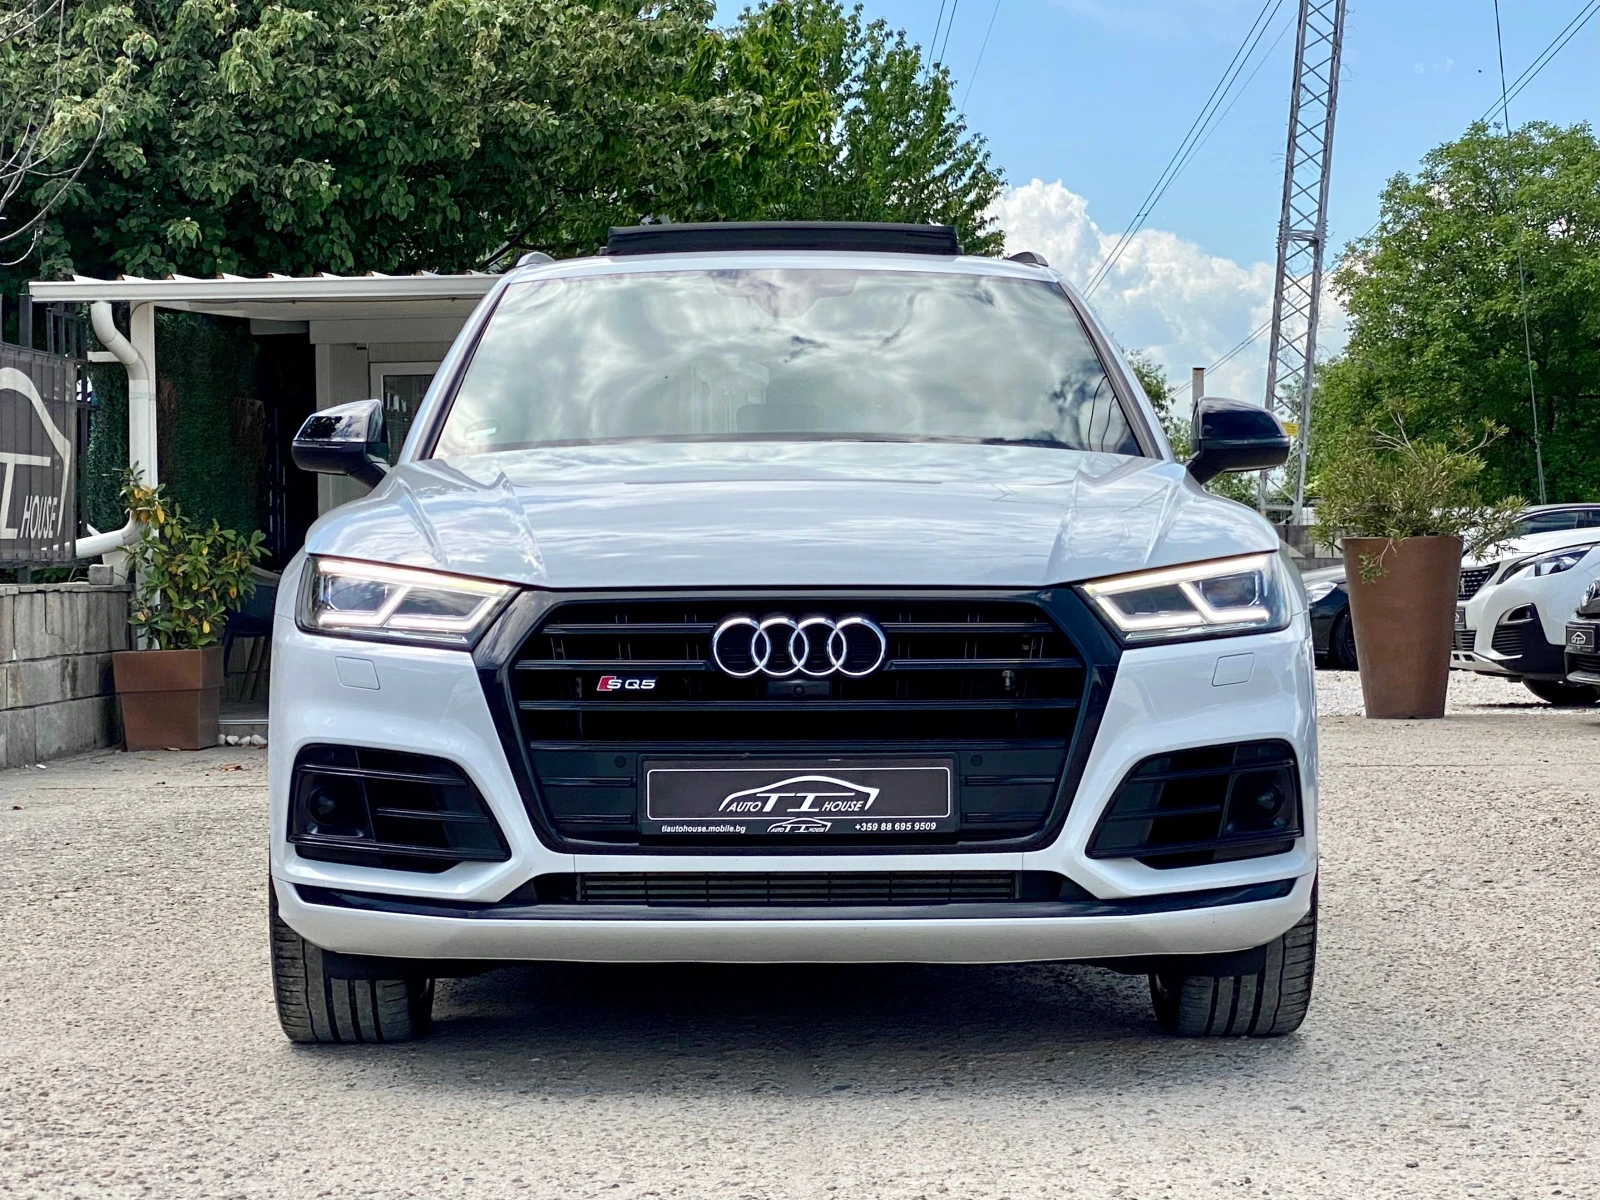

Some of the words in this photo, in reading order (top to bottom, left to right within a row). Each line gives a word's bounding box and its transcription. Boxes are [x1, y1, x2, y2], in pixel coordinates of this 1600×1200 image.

[20, 495, 58, 539] HOUSE
[606, 678, 656, 690] SQ5
[726, 801, 761, 812] AUTO
[821, 801, 863, 812] HOUSE
[661, 825, 746, 834] tiautohouse.mobile.bg
[855, 823, 878, 831] +359
[880, 822, 892, 831] 88
[894, 822, 912, 831] 695
[914, 822, 936, 830] 9509
